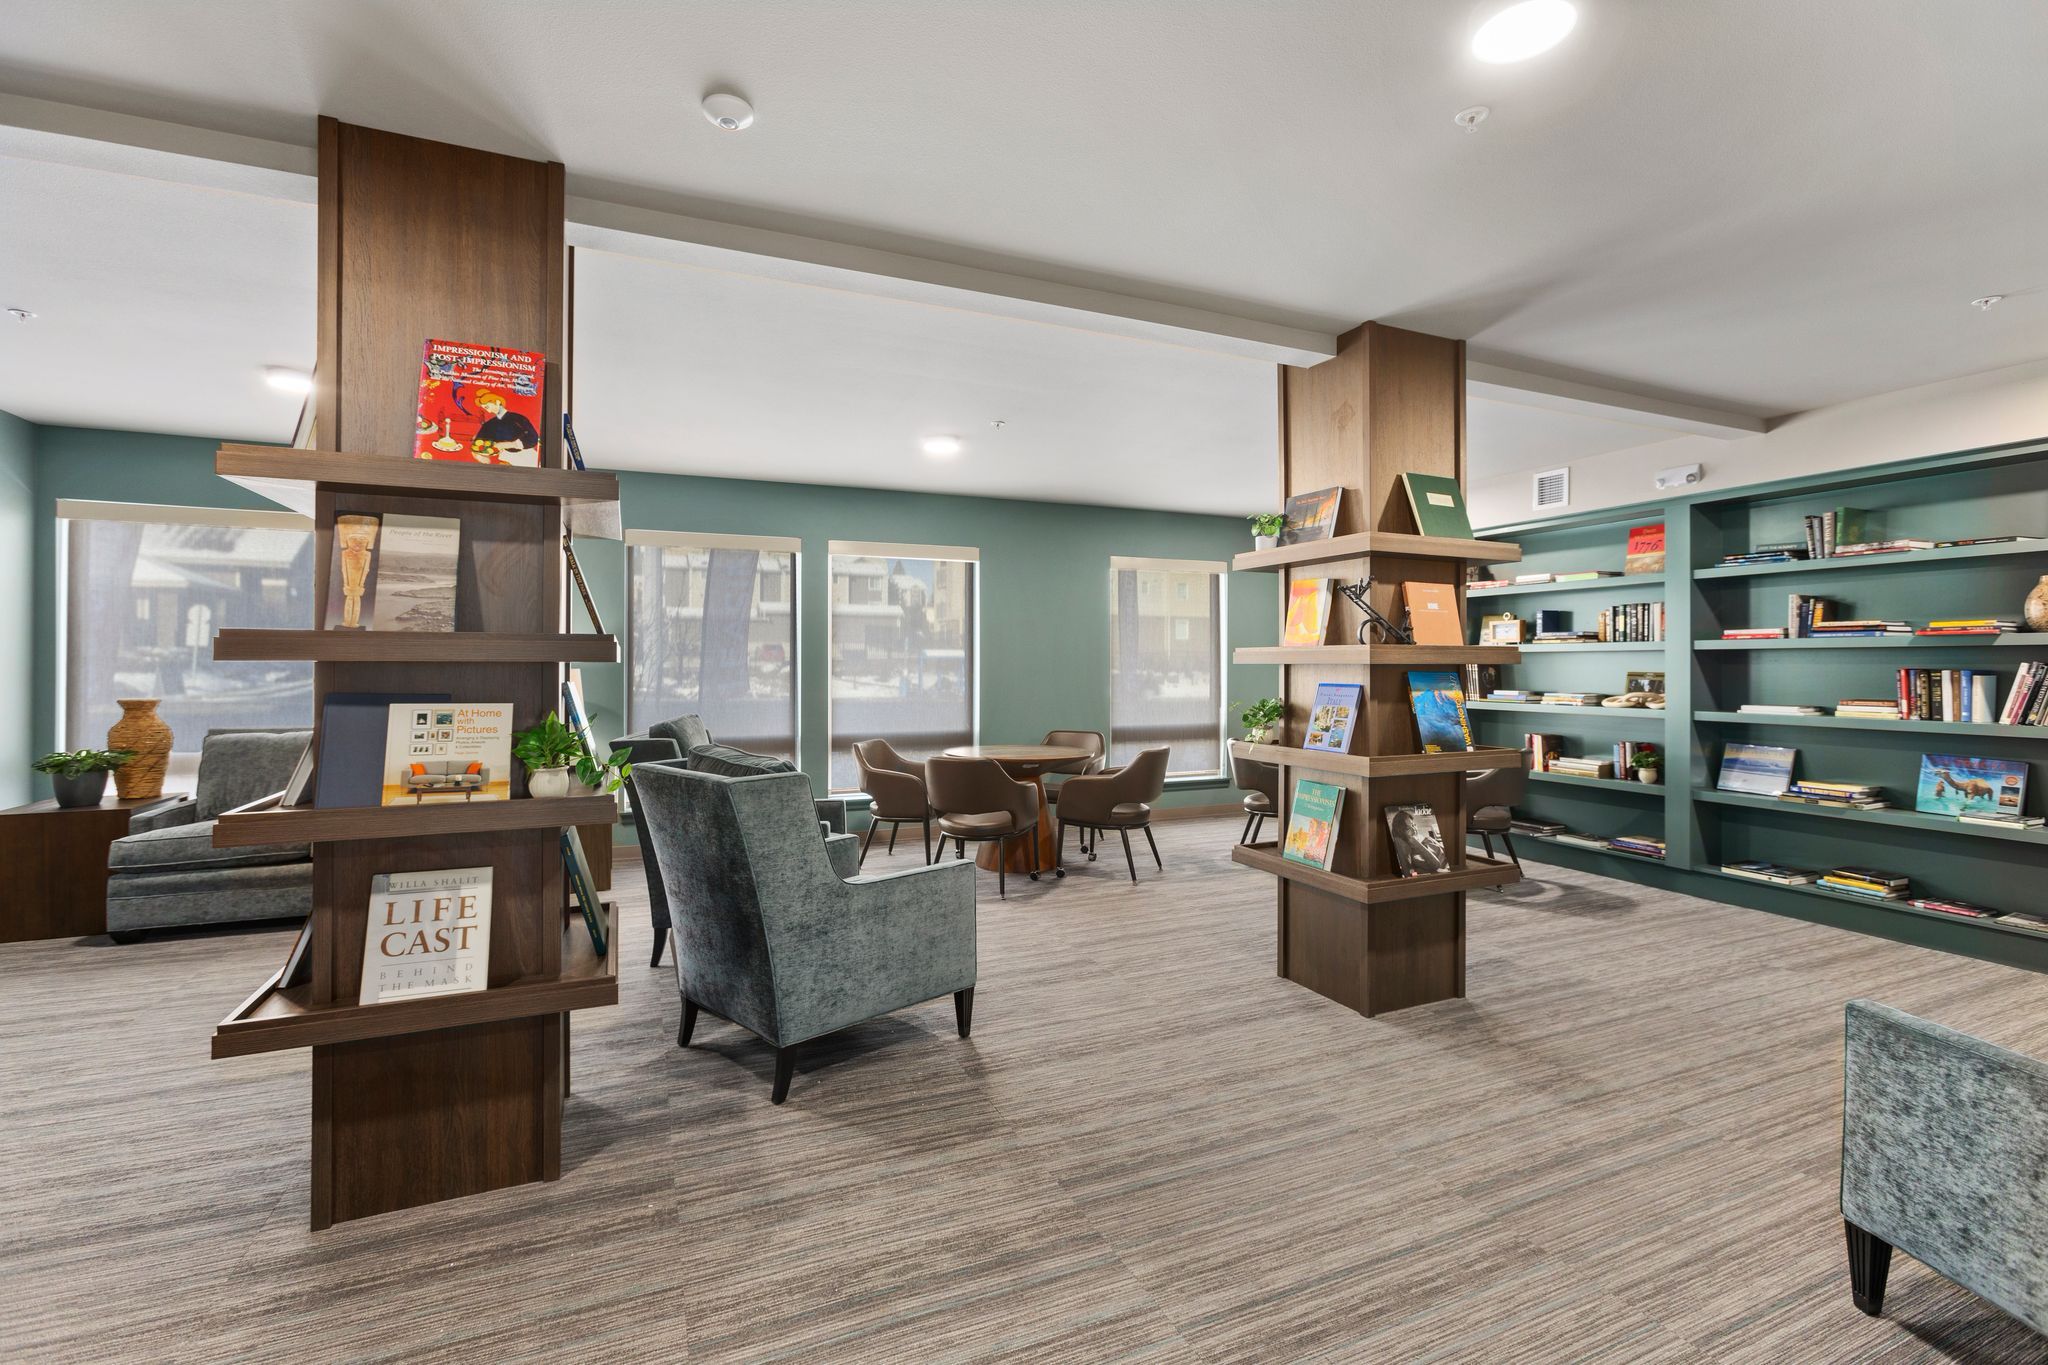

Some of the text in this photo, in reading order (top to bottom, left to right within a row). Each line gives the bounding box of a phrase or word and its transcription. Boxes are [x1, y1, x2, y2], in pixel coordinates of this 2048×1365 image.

[433, 344, 532, 363] IMPRESSIONISM AND
[1634, 539, 1663, 554] 1776
[456, 717, 475, 725] with
[457, 709, 503, 718] At Home
[456, 726, 498, 734] Pictures
[389, 876, 480, 889] WILLA SHALIT
[383, 895, 478, 926] LIFE
[380, 925, 478, 957] CAST
[380, 963, 473, 980] BEHIND
[379, 975, 472, 993] THE MASK
